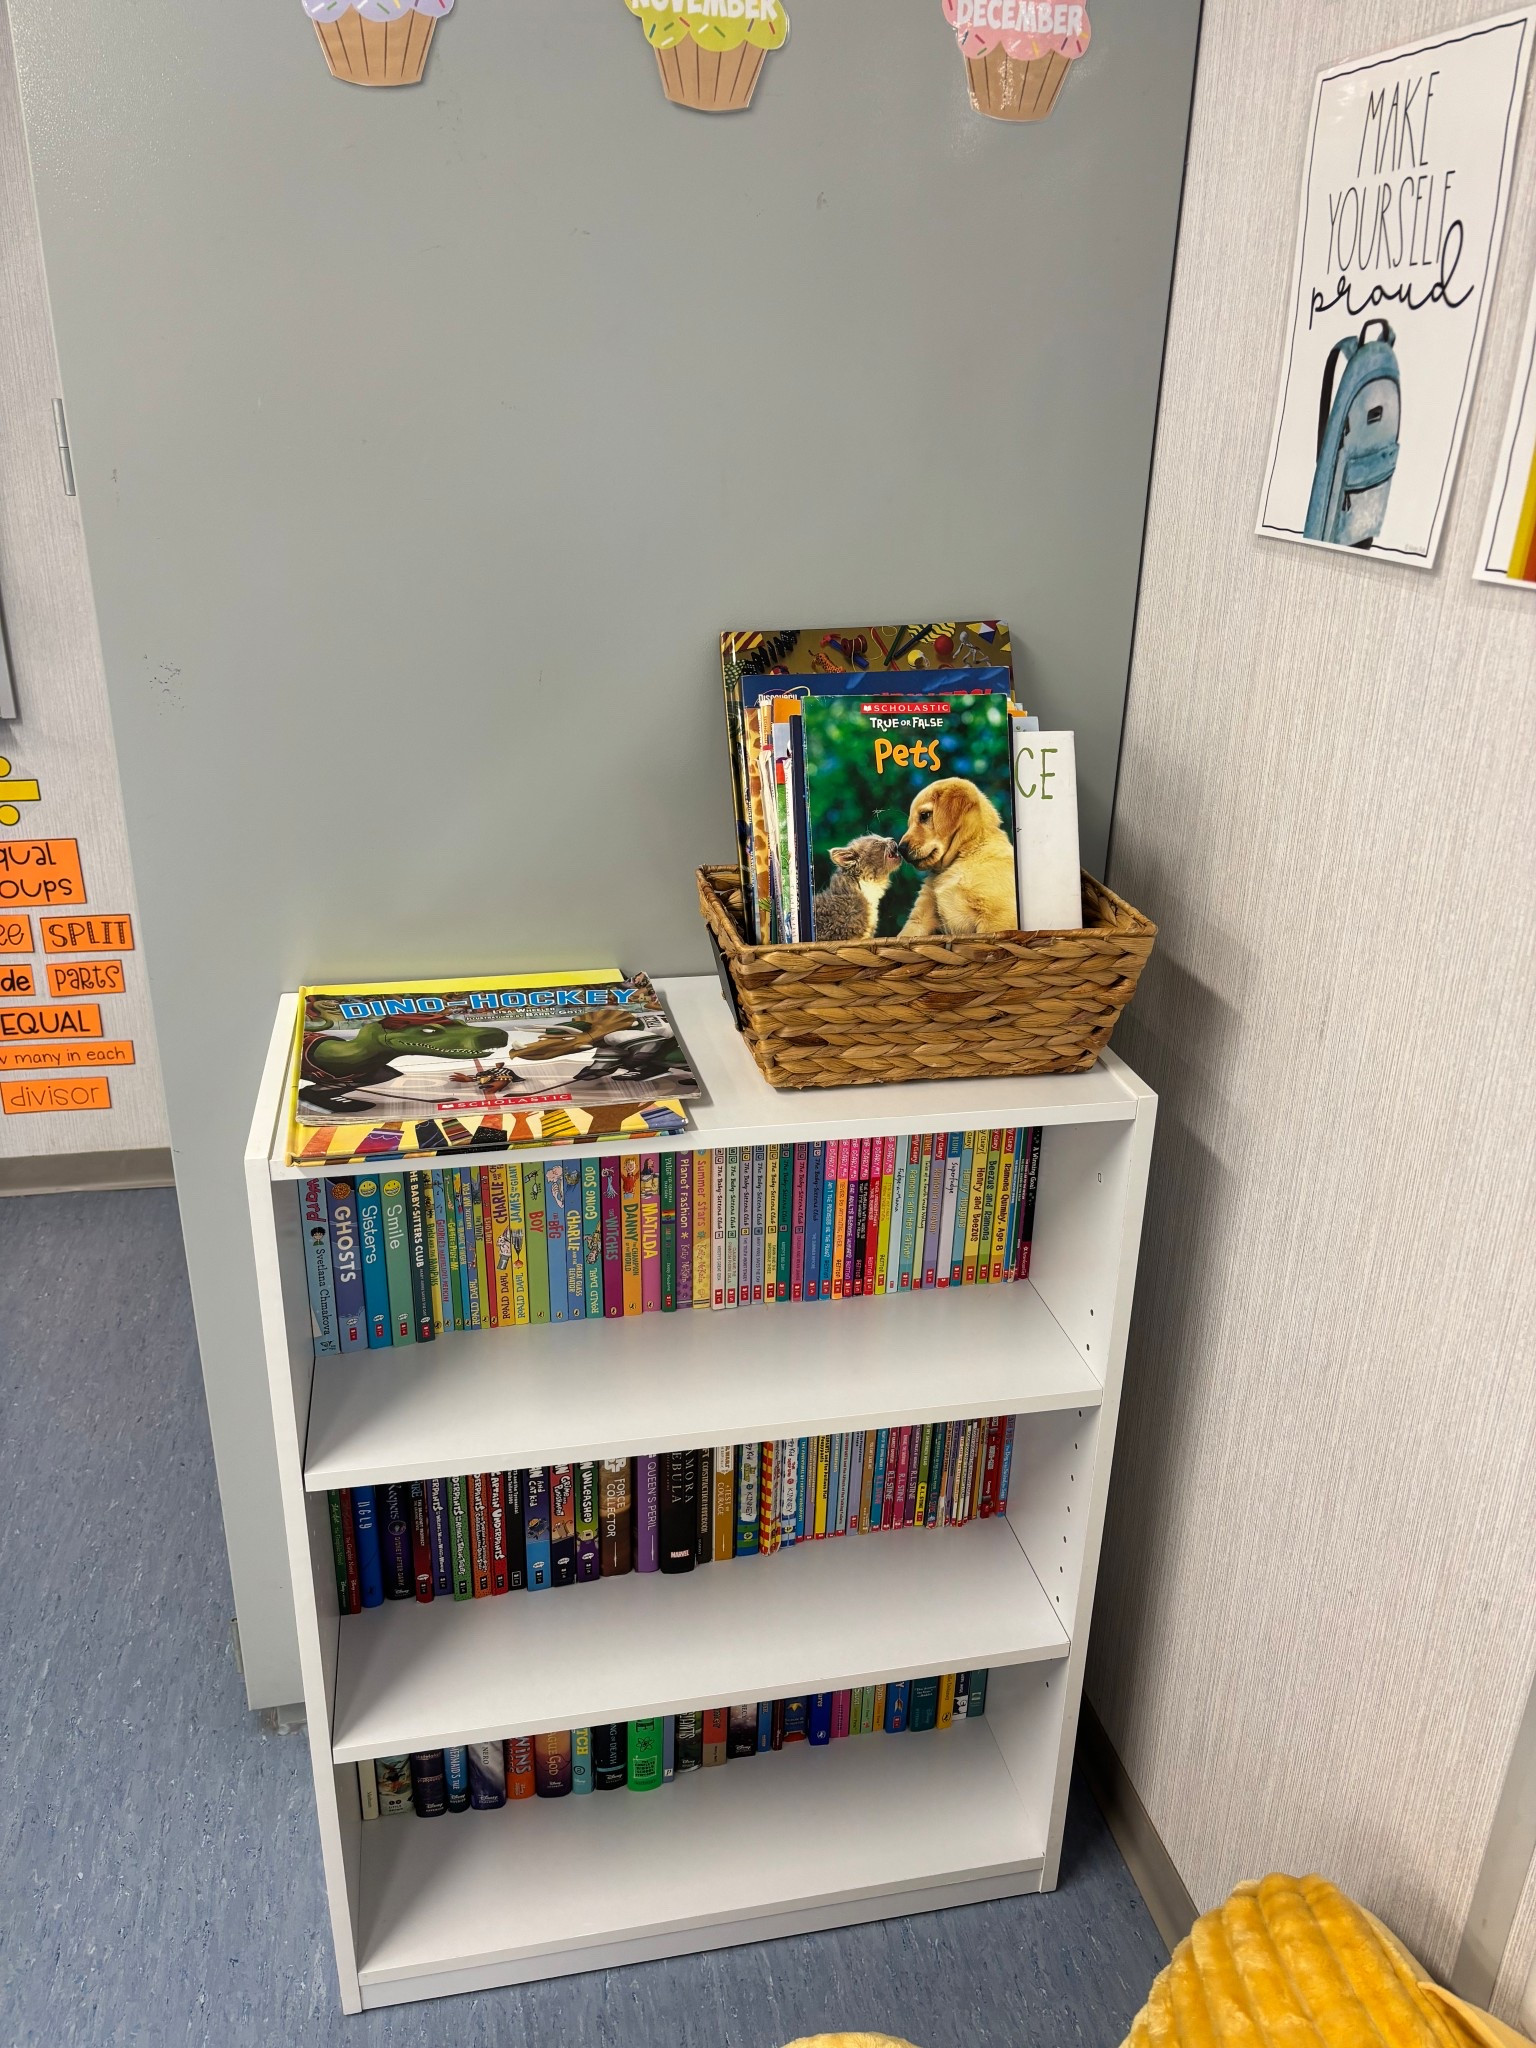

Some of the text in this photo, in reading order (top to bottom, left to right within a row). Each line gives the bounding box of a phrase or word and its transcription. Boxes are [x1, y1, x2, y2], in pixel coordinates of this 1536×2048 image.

[631, 0, 778, 21] MBER
[957, 0, 1083, 36] DECEMBER
[1357, 71, 1440, 178] MAKE
[1327, 170, 1455, 275] YOURSELF
[1309, 219, 1474, 332] proud
[870, 717, 899, 732] TRUE
[912, 717, 943, 728] FALSE
[874, 738, 941, 774] Pets
[48, 920, 127, 947] SPLIT
[338, 988, 639, 1020] DINO-HOCKEY
[0, 1009, 91, 1036] EQUAL
[14, 1052, 61, 1066] many
[67, 1048, 81, 1061] in
[86, 1046, 126, 1061] each
[10, 1085, 100, 1107] divisor
[457, 1094, 571, 1108] SCHOLASTIC
[1006, 1135, 1014, 1152] Cleary
[680, 1159, 690, 1189] Planet
[697, 1160, 707, 1198] Summer
[946, 1162, 958, 1194] Superfudge
[987, 1160, 998, 1190] Beezus
[1002, 1163, 1011, 1191] Ramona
[1029, 1152, 1039, 1175] Winning
[462, 1183, 470, 1195] FOX
[584, 1167, 597, 1220] GOING SOLO
[769, 1174, 777, 1211] Baby-Sitters
[797, 1174, 805, 1211] Baby-Sitters
[932, 1168, 942, 1200] Ramona
[960, 1168, 971, 1194] Henry
[970, 1135, 986, 1242] Cleary Henry and Beezus
[410, 1184, 422, 1243] BABY-SITTERS
[491, 1182, 507, 1223] CHARLIE
[509, 1193, 523, 1223] JAMES
[680, 1193, 690, 1228] Fashion
[697, 1202, 708, 1227] Stars
[904, 1169, 917, 1259] Ramona and Her Father
[958, 1197, 969, 1228] Huggins
[985, 1193, 994, 1207] and
[998, 1194, 1010, 1225] Quimby,
[386, 1205, 404, 1250] Smile
[475, 1223, 483, 1241] TWITS
[529, 1211, 544, 1232] BOY
[548, 1220, 564, 1239] BFG
[566, 1210, 581, 1251] CHARLIE
[624, 1203, 638, 1242] DANNY
[642, 1202, 658, 1259] MATILDA
[797, 1211, 805, 1224] Club
[929, 1202, 939, 1235] Forever
[982, 1211, 992, 1241] Ramona
[334, 1206, 356, 1283] GHOSTS
[362, 1205, 378, 1264] Sisters
[605, 1217, 619, 1261] WITCHES
[996, 1227, 1005, 1242] Age
[316, 1249, 329, 1286] Svetlana
[415, 1246, 424, 1268] CLUB
[631, 1248, 639, 1276] CHAMPION
[469, 1279, 479, 1325] ROALD DAHL
[500, 1273, 510, 1319] ROALD DAHL
[515, 1273, 525, 1318] ROALD DAHL
[319, 1289, 331, 1336] Chmakova
[614, 1478, 625, 1508] FORCE
[671, 1452, 682, 1503] EBULA
[885, 1471, 895, 1500] R.L. STINE
[908, 1482, 917, 1500] STINE
[606, 1483, 616, 1538] COLLECTOR
[647, 1462, 656, 1531] QUEEN'S PERIL
[717, 1482, 726, 1516] COURAGE
[745, 1492, 754, 1517] KINNEY
[786, 1488, 794, 1513] KINNEY
[358, 1501, 373, 1529] UGLY
[492, 1508, 505, 1560] UNDERPANTS
[670, 1550, 689, 1558] MARVEL
